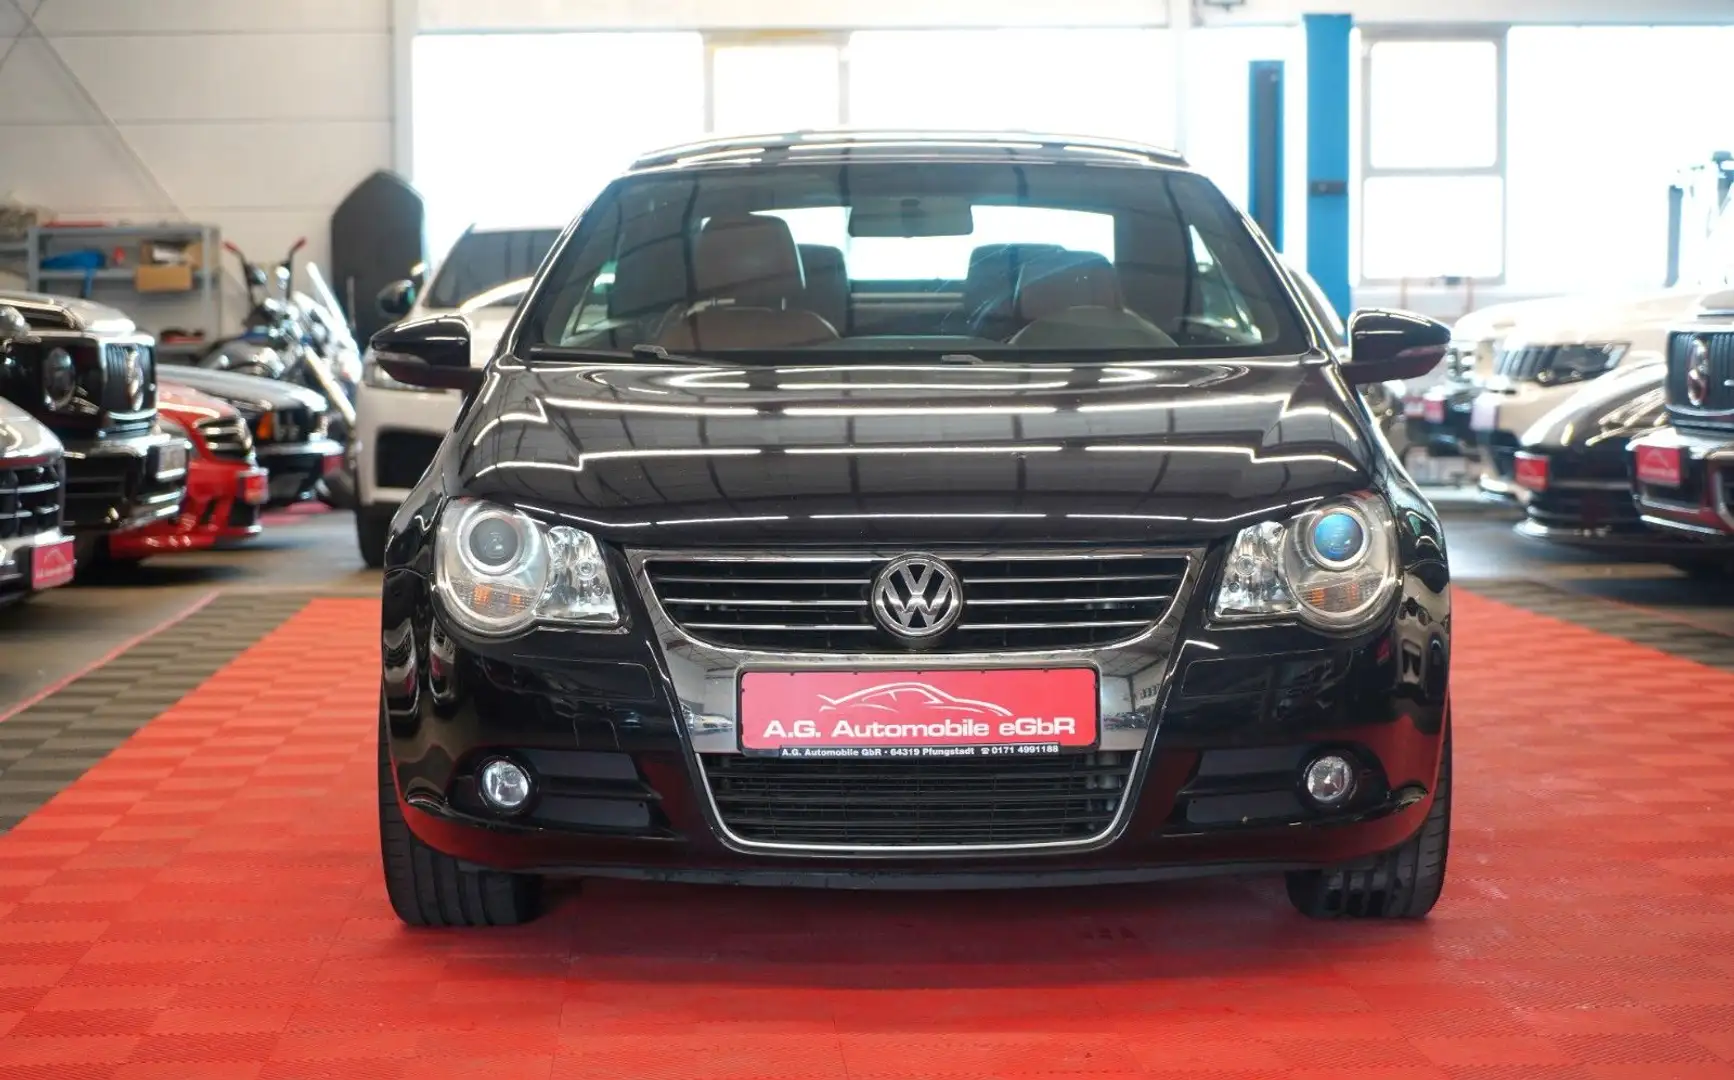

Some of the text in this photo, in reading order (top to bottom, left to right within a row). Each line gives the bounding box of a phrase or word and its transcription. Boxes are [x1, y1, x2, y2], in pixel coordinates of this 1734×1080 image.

[762, 717, 1076, 739] A.G. Automobile eGbR
[781, 744, 1059, 757] A.G. Automobile GbR 64319 Pfungstadt 0171 4991188
